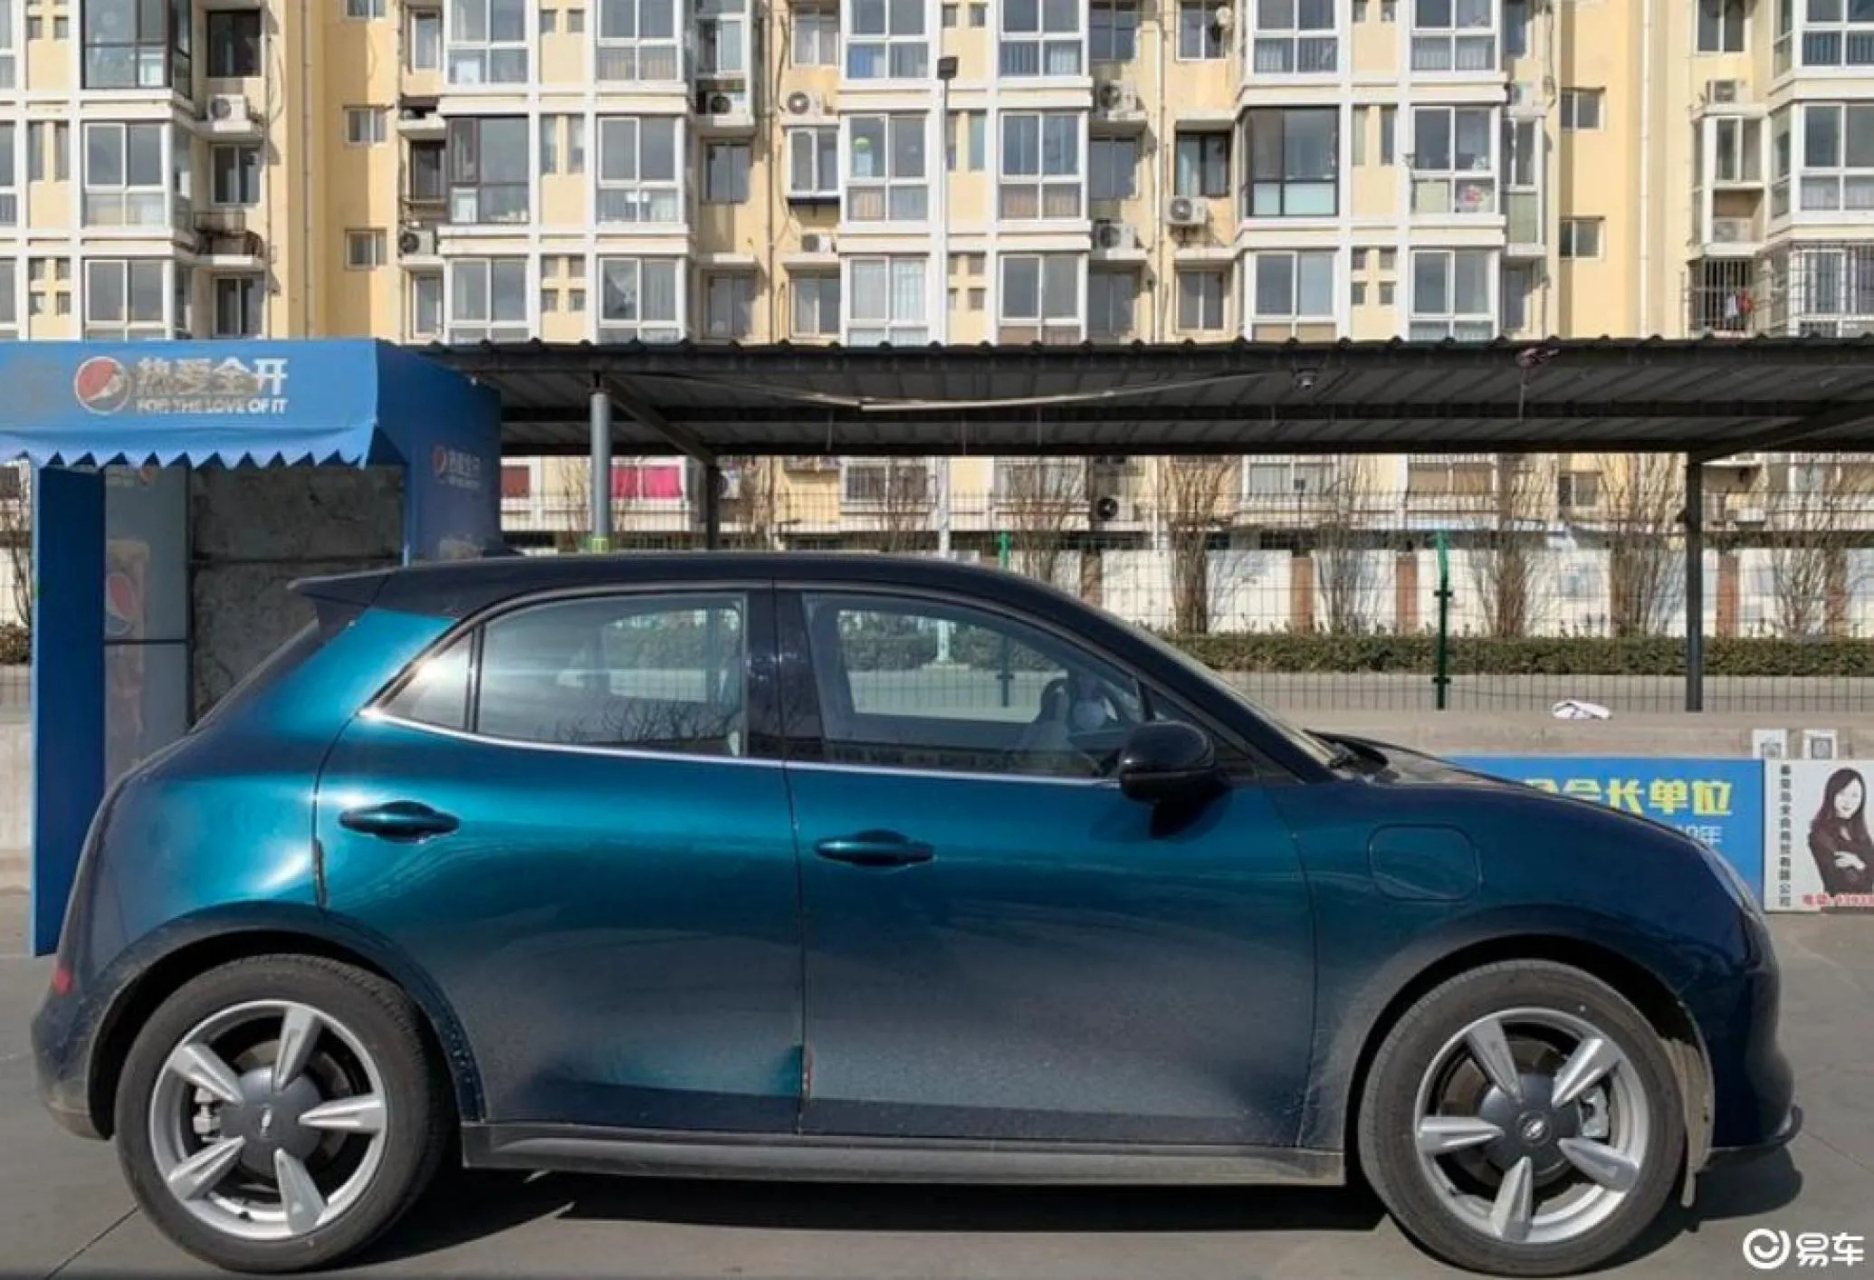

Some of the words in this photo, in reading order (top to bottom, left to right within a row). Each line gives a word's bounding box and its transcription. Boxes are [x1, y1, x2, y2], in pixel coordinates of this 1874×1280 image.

[136, 398, 170, 414] FOR
[206, 398, 246, 414] LOVE
[247, 397, 270, 413] OF
[272, 397, 289, 413] IT
